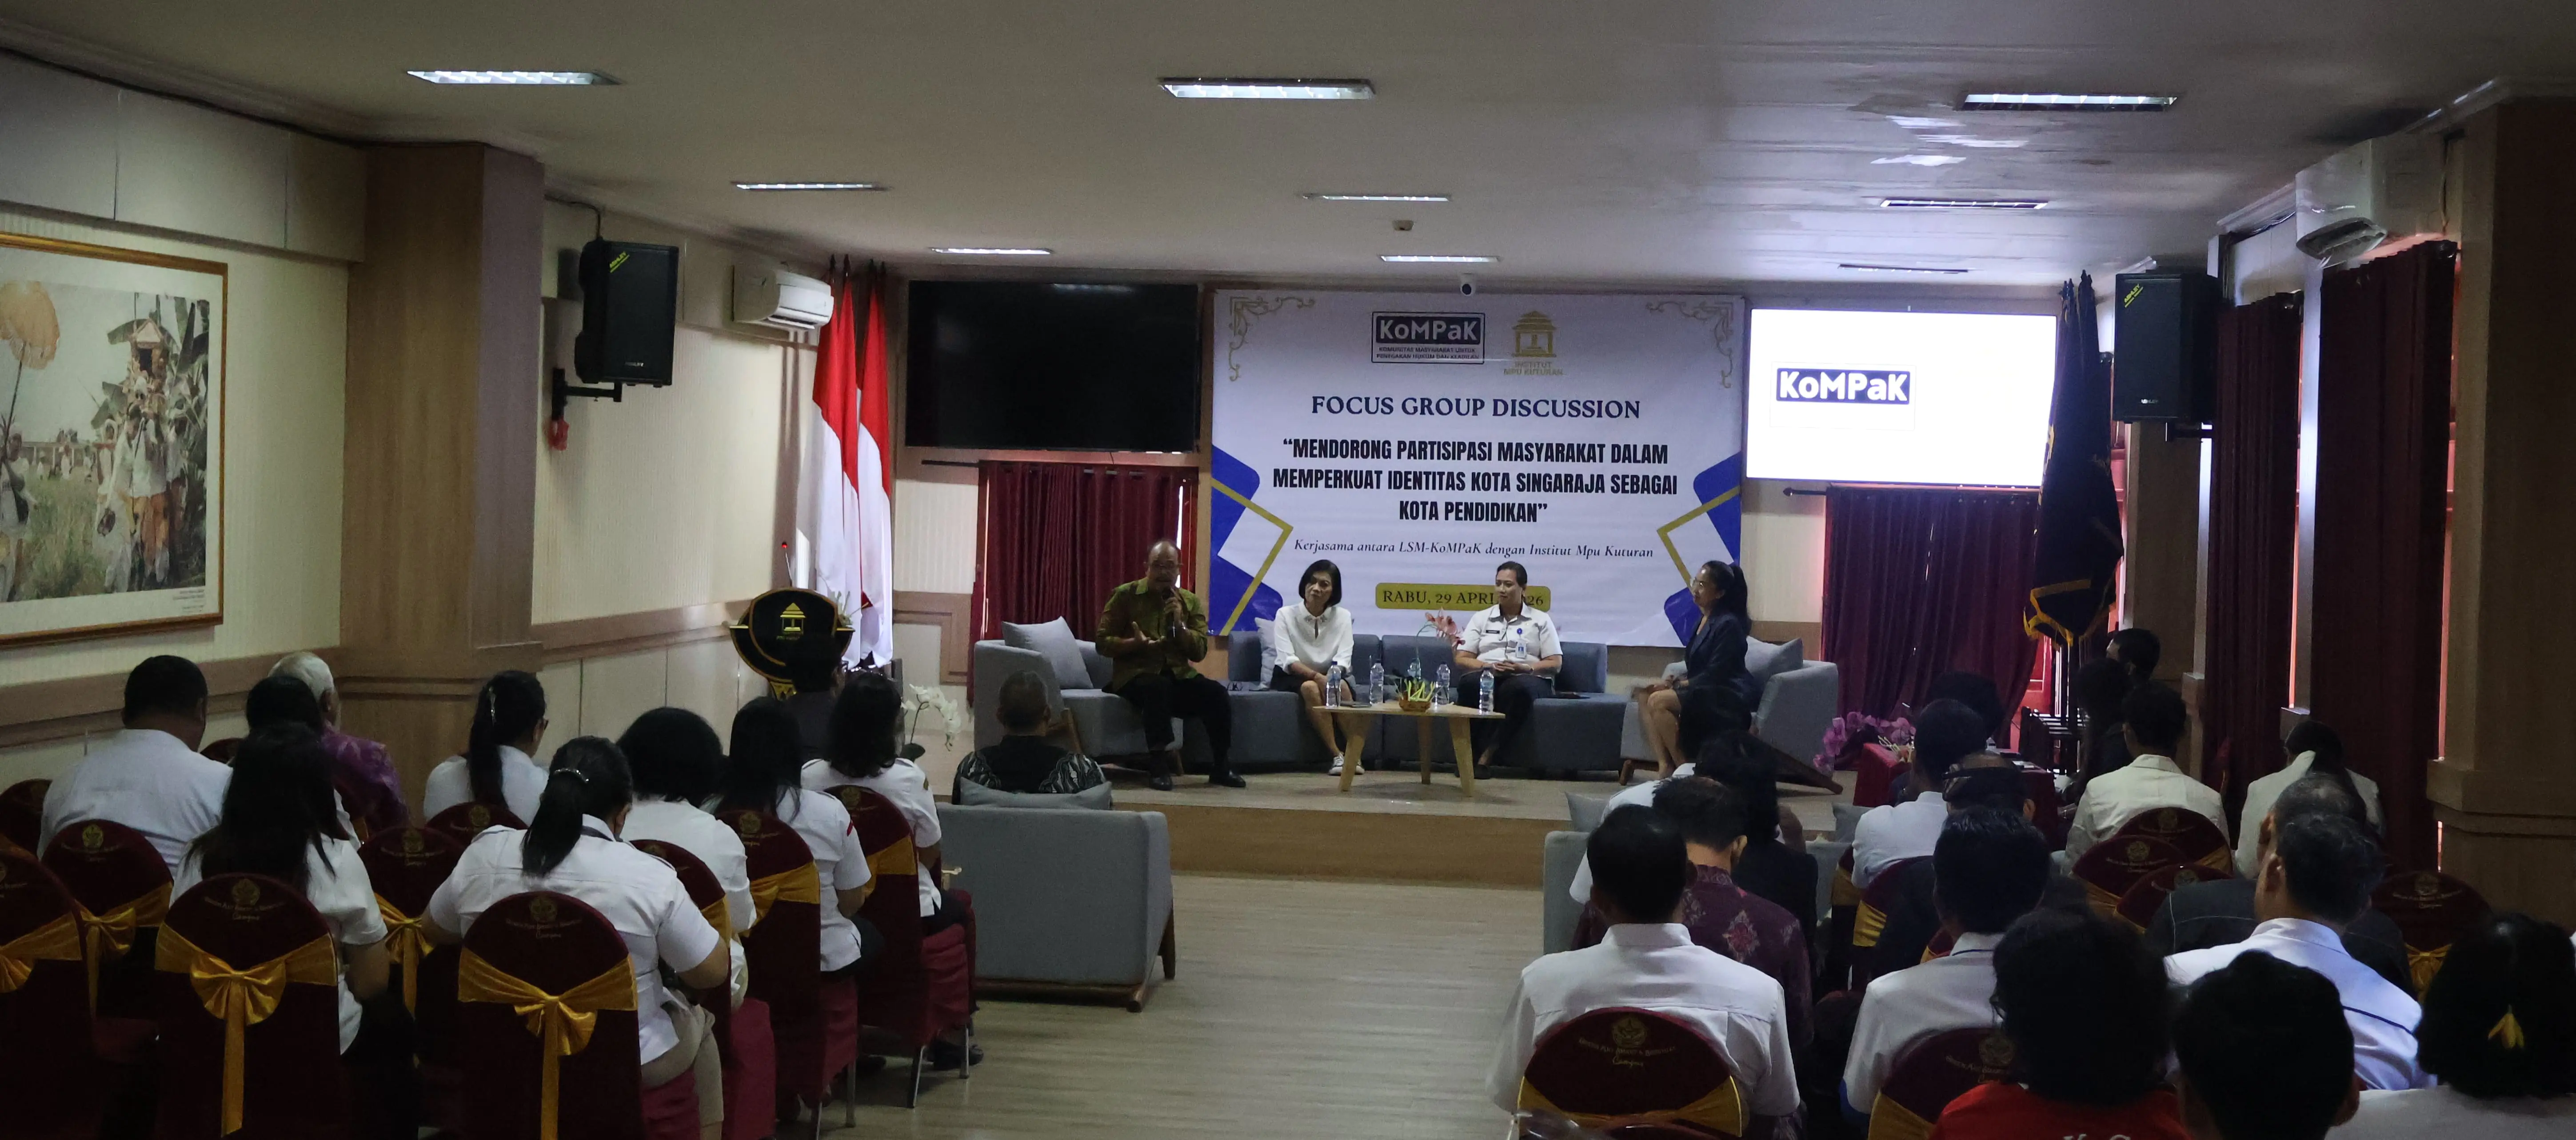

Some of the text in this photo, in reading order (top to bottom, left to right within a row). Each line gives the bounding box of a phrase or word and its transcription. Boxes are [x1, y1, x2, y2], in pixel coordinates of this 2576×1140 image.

[1380, 320, 1478, 341] KoMPaK
[1779, 371, 1908, 401] KoMPaK
[1312, 396, 1640, 418] FOCUS GROUP DISCUSSION
[1283, 438, 1668, 464] “MENDORONG PARTISIPASI MASYARAKAT DALAM
[1274, 468, 1677, 495] MEMPERKUAT IDENTITAS KOTA SINGARAJA SEBAGAI
[1399, 500, 1548, 522] KOTA PENDIDIKAN”
[1294, 539, 1653, 560] Kerjasama antara LSM-KoMPaK dengan Institut Mpu Kuturan
[1383, 590, 1430, 604] RABU,
[1436, 593, 1451, 604] 29
[1456, 592, 1495, 605] APRI
